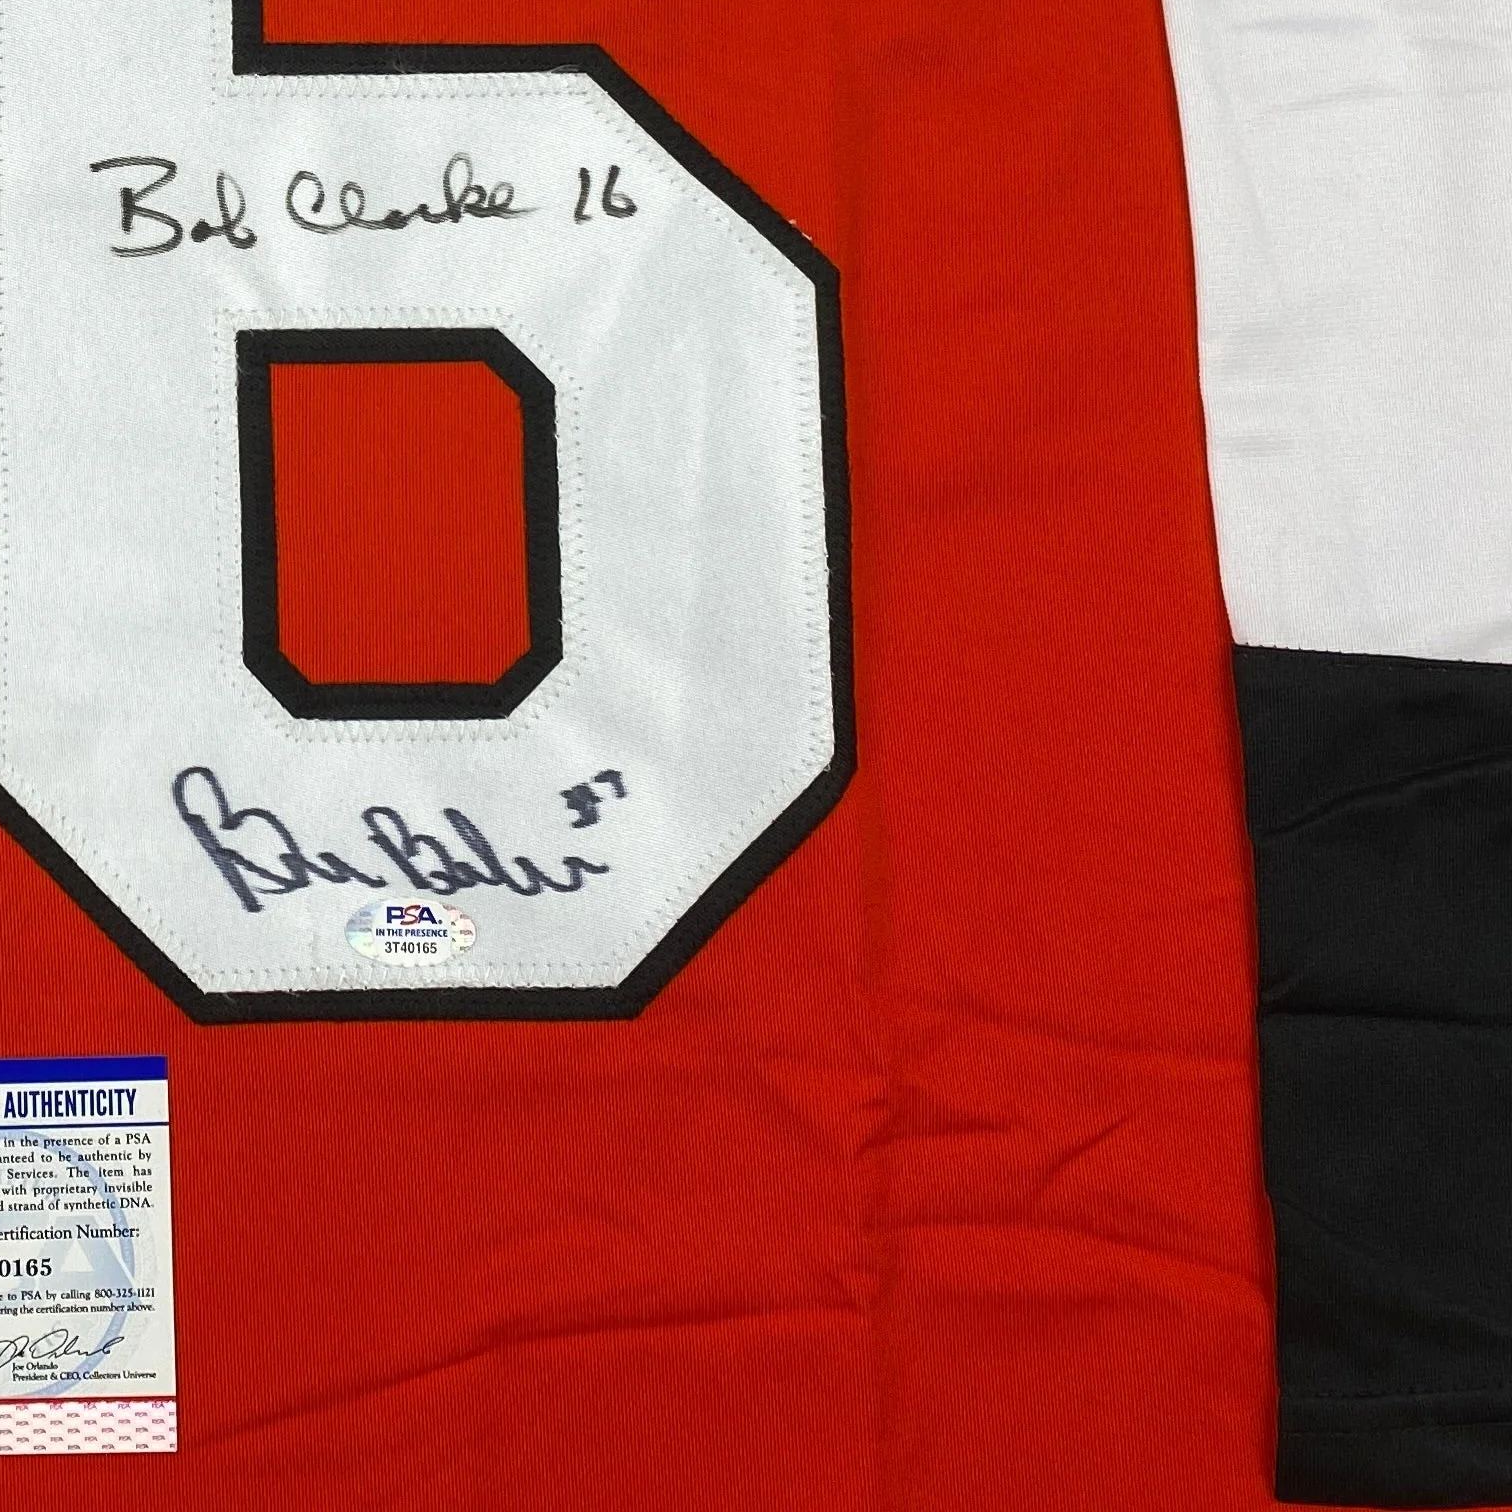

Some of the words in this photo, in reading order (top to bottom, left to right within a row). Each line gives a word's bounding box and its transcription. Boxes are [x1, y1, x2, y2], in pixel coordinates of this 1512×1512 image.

[90, 155, 257, 257] Bob
[286, 152, 540, 235] Clarke
[573, 165, 637, 224] 16
[387, 929, 402, 937] THE
[405, 929, 448, 937] PRESENCE
[385, 942, 437, 954] 3T40165
[4, 1089, 136, 1119] AUTHENTICITY
[4, 1138, 15, 1147] in
[20, 1136, 38, 1147] the
[44, 1137, 93, 1149] presence
[98, 1134, 110, 1145] of
[126, 1133, 151, 1144] PSA
[41, 1153, 52, 1162] to
[59, 1151, 71, 1162] be
[78, 1149, 132, 1161] authentic
[139, 1149, 152, 1162] by
[7, 1168, 57, 1179] Services.
[66, 1166, 90, 1177] The
[99, 1168, 123, 1177] item
[133, 1165, 152, 1176] has
[2, 1184, 27, 1195] with
[34, 1184, 97, 1197] proprietary
[104, 1181, 152, 1192] invisible
[8, 1200, 43, 1211] strand
[48, 1199, 60, 1210] of
[64, 1197, 116, 1212] synthetic
[120, 1197, 154, 1209] DNA.
[76, 1224, 139, 1239] Number:
[8, 1293, 17, 1301] to
[21, 1291, 41, 1300] PSA
[46, 1290, 56, 1301] by
[61, 1288, 90, 1300] calling
[95, 1288, 155, 1298] 800-325-1121
[20, 1303, 33, 1314] the
[37, 1301, 88, 1313] certification
[91, 1301, 124, 1312] number
[127, 1301, 155, 1312] above.
[12, 1362, 24, 1371] Joe
[26, 1362, 58, 1370] Orlando
[13, 1373, 47, 1381] President
[83, 1371, 120, 1380] Collectors
[123, 1371, 156, 1379] Universe
